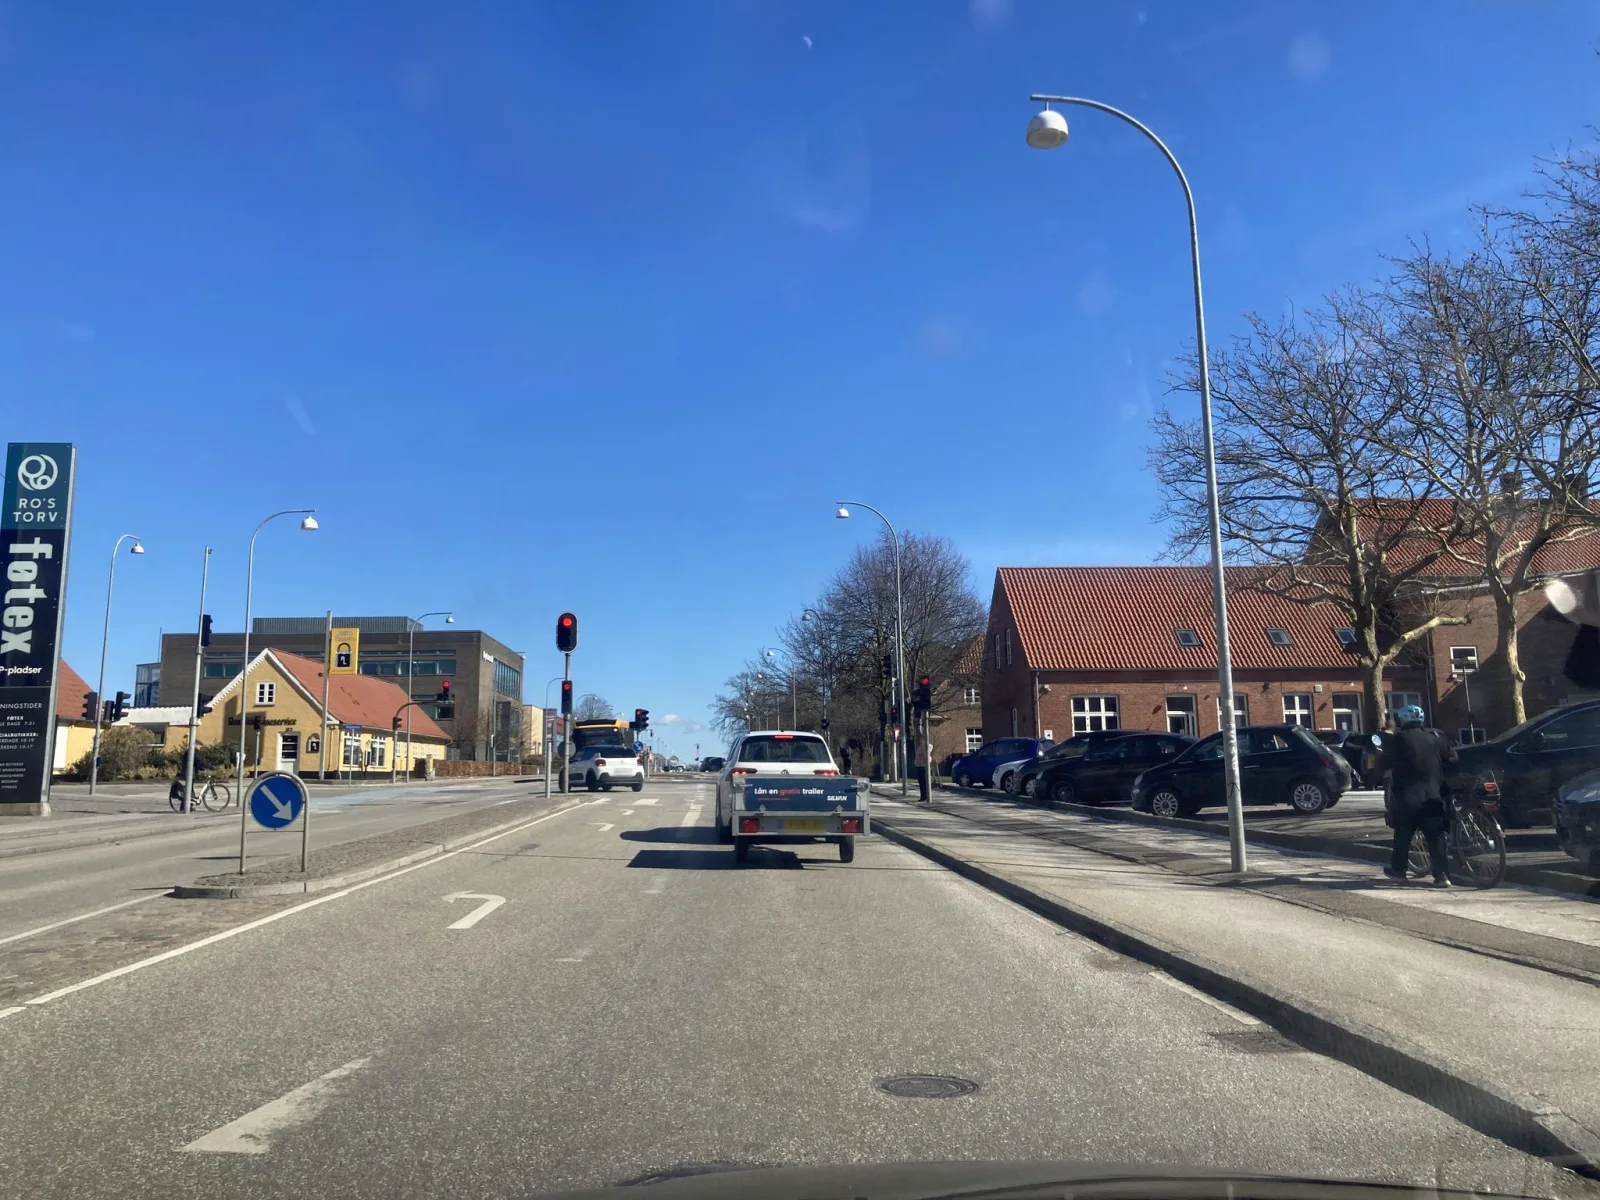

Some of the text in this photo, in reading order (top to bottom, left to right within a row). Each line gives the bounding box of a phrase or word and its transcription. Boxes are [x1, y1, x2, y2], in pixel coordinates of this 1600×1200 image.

[19, 498, 56, 508] RO'S
[13, 511, 58, 522] TORV
[0, 536, 53, 654] føtex
[754, 787, 768, 795] Lån
[779, 788, 801, 796] gratis
[802, 787, 824, 795] trailer
